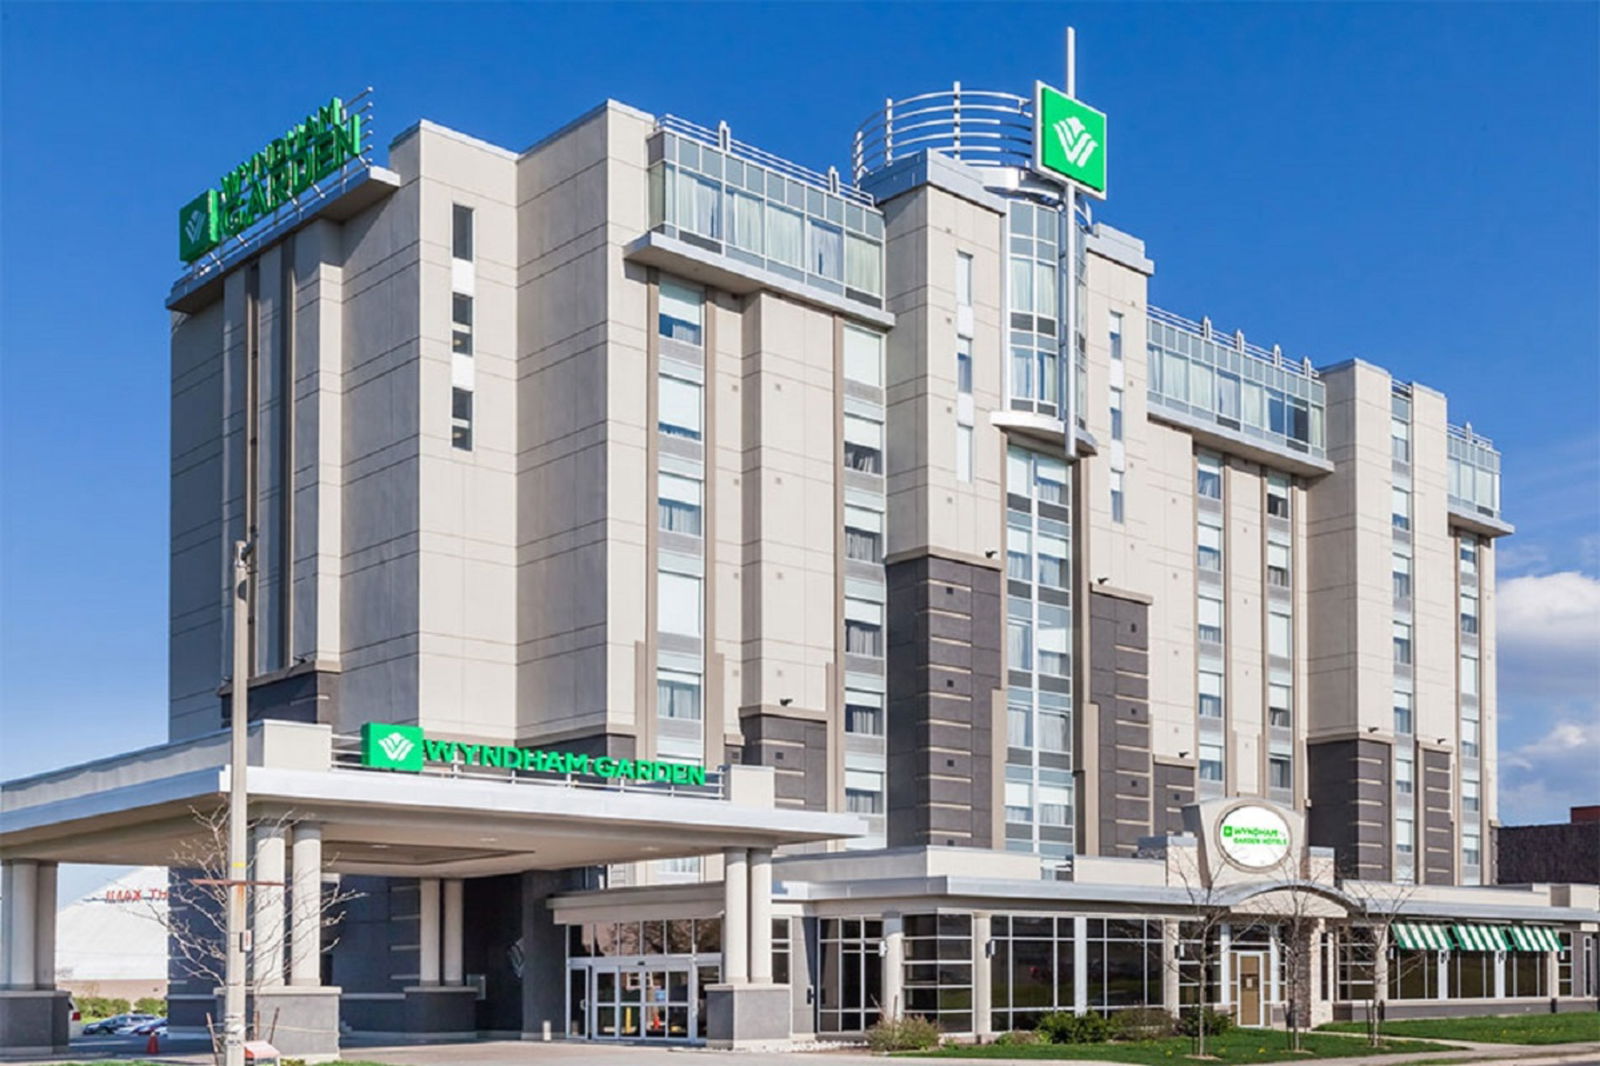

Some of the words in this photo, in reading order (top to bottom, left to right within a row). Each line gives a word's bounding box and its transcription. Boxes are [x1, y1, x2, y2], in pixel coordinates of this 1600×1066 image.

[221, 97, 347, 196] WYNDHAM
[222, 114, 361, 236] GARDEN
[424, 739, 588, 773] WYNDHAM
[593, 758, 706, 785] GARDEN
[1234, 827, 1279, 836] WYNDHAM
[106, 889, 142, 901] IMAX
